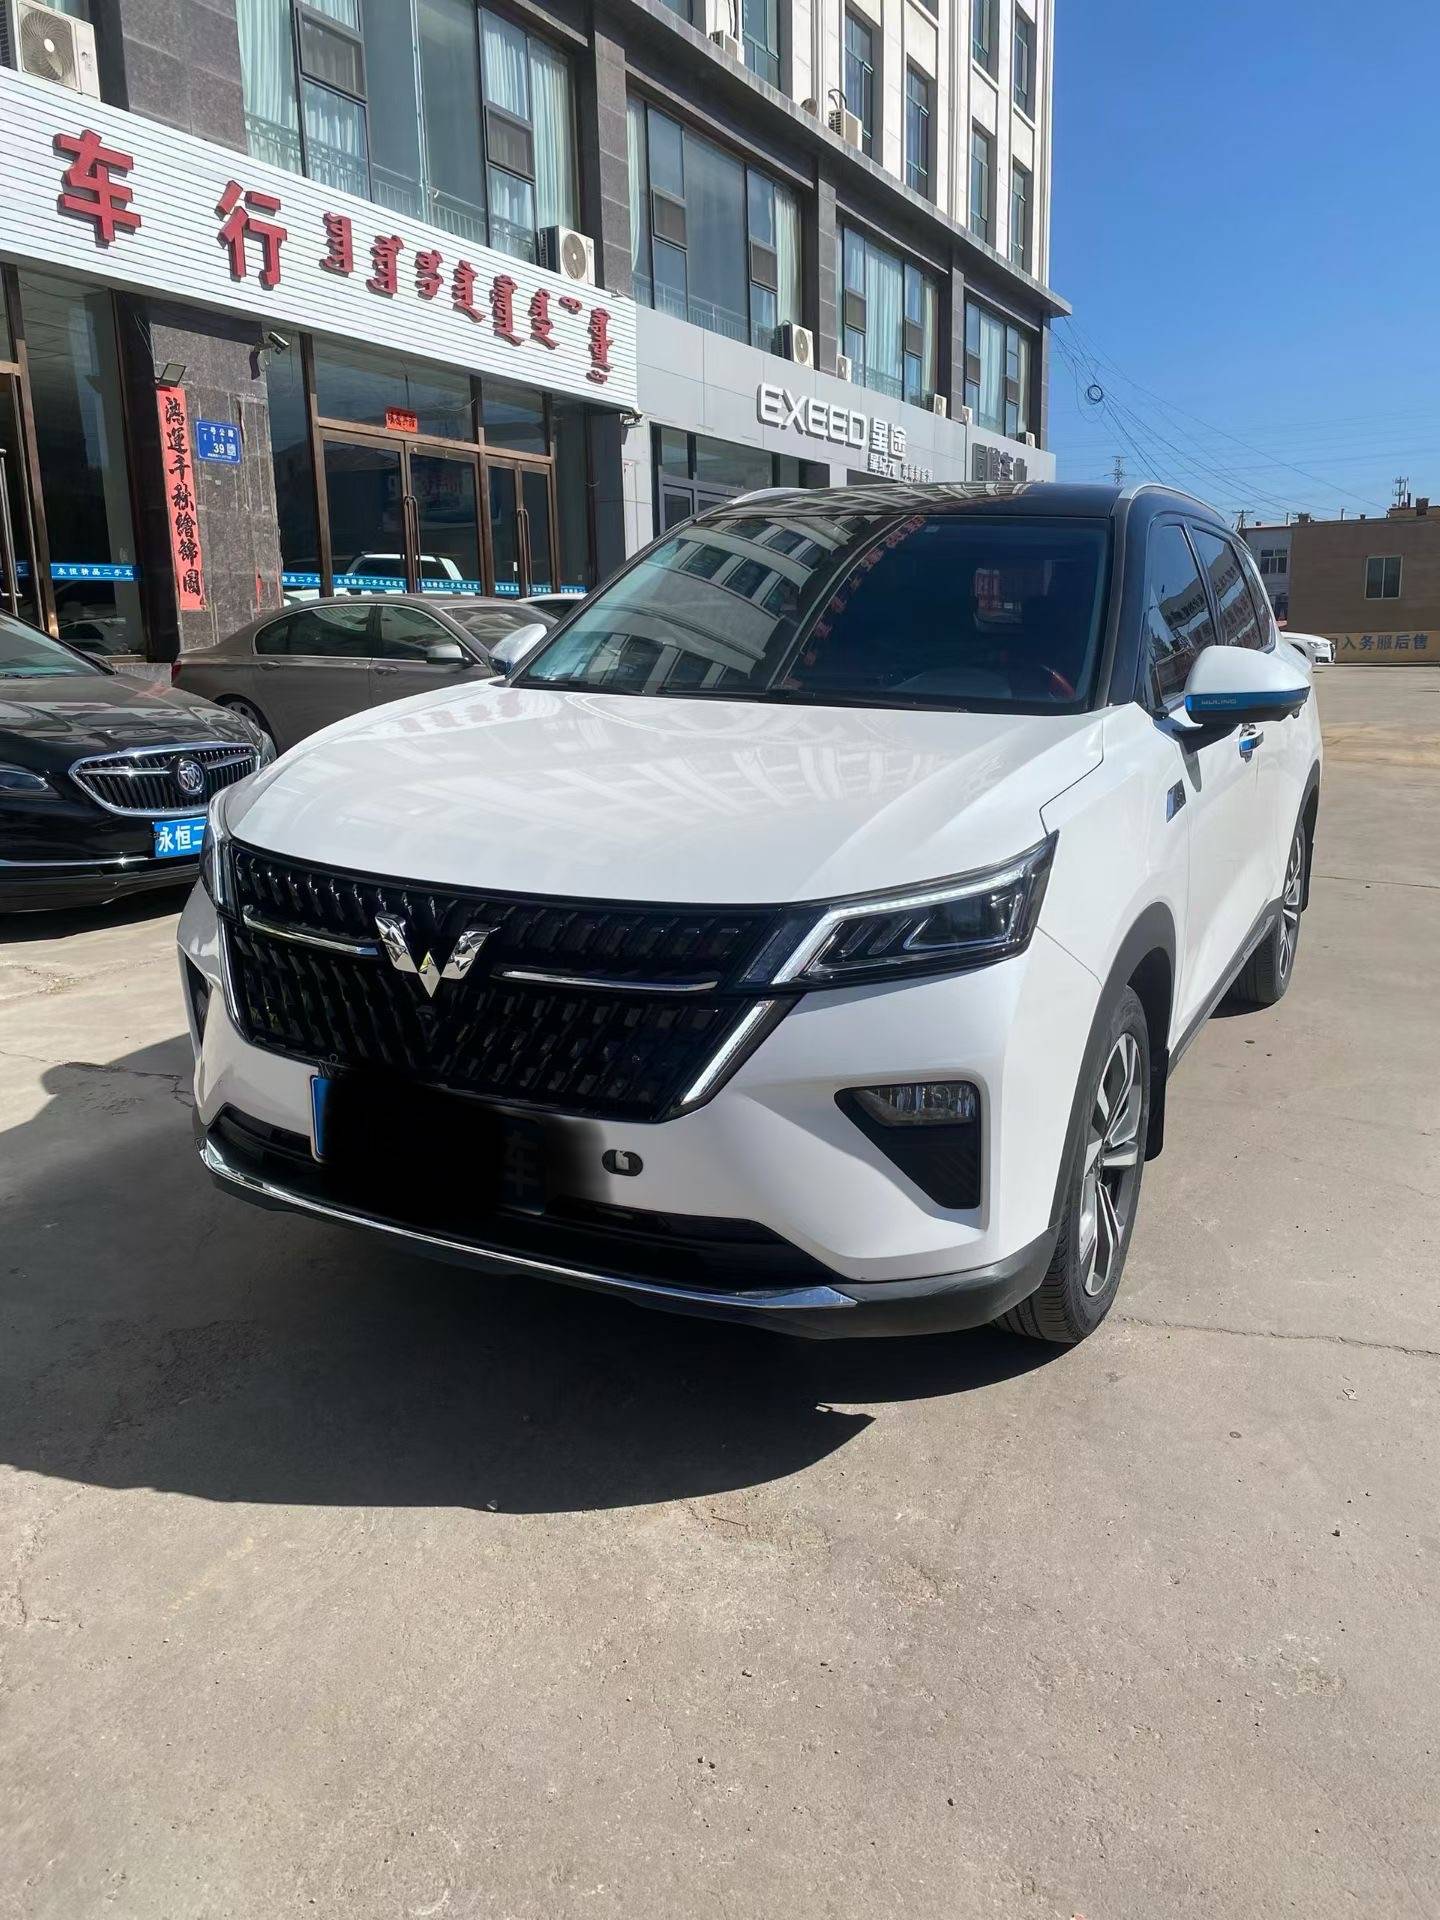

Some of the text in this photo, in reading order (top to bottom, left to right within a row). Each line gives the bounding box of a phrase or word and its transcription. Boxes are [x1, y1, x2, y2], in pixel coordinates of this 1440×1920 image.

[53, 129, 287, 290] 车行
[758, 383, 868, 449] EXEED
[870, 417, 906, 460] 星途
[213, 443, 225, 454] 39
